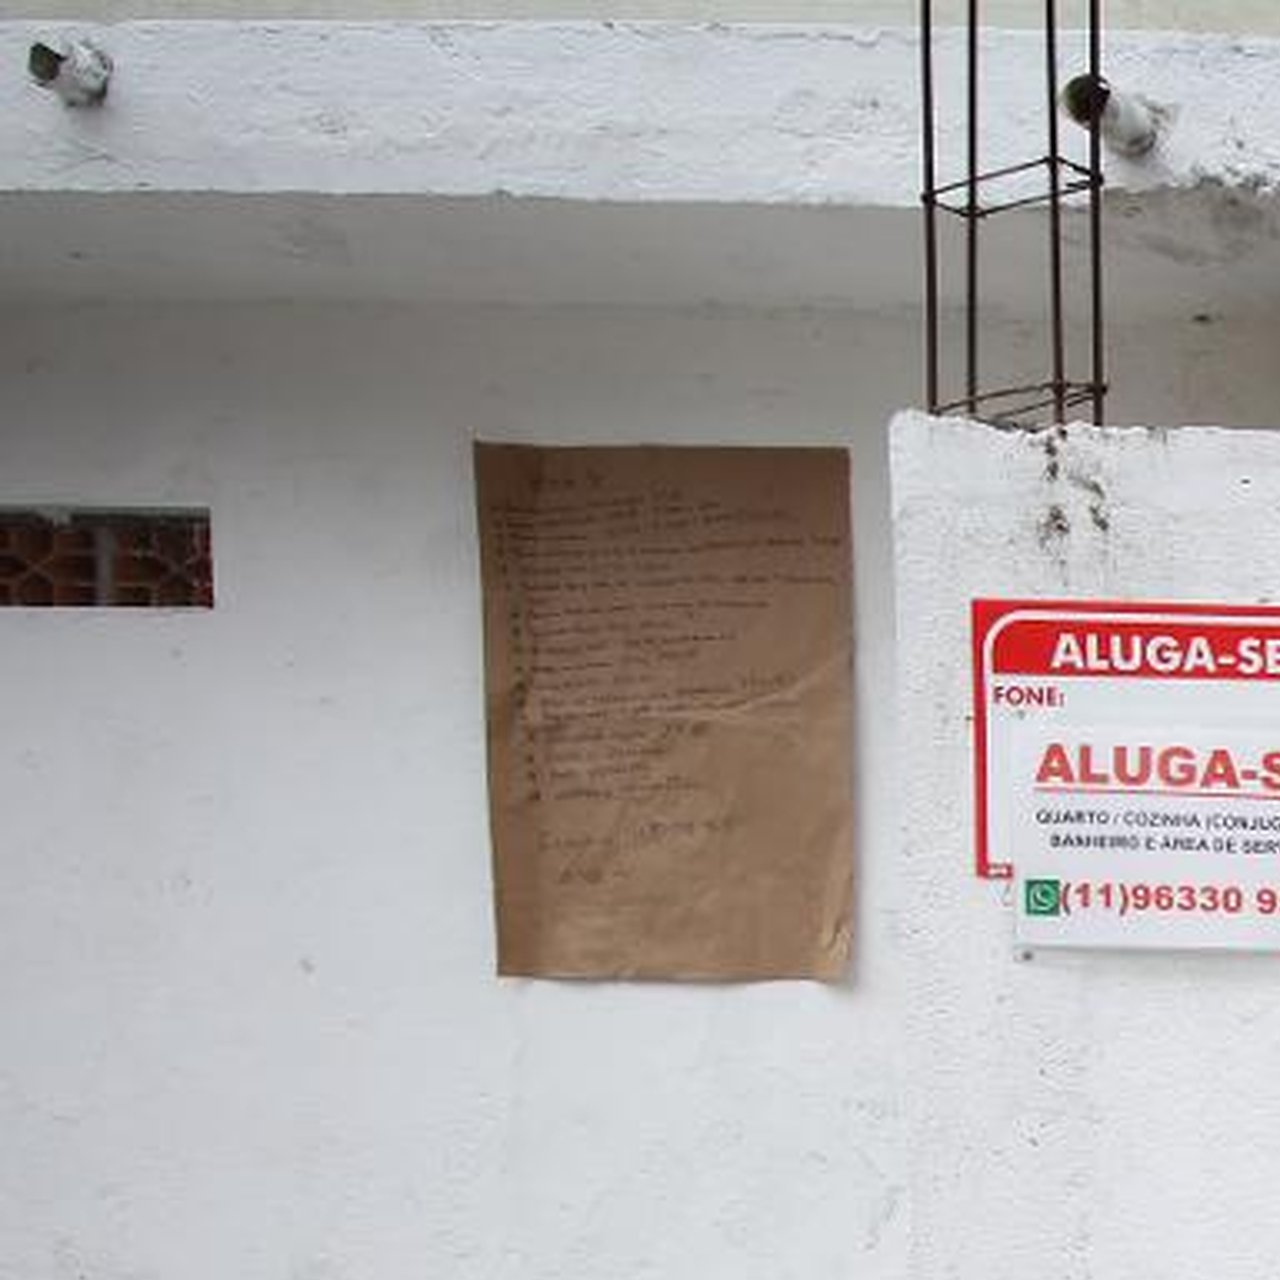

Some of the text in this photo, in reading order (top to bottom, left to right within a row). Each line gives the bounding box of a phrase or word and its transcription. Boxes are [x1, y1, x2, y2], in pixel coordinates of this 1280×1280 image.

[993, 686, 1065, 708] FONE:
[1035, 808, 1108, 825] QUARTO
[1122, 811, 1201, 829] COZINHA
[1049, 835, 1140, 851] BANHEIRO
[1213, 837, 1237, 854] DE
[1062, 882, 1242, 916] (11)96330
